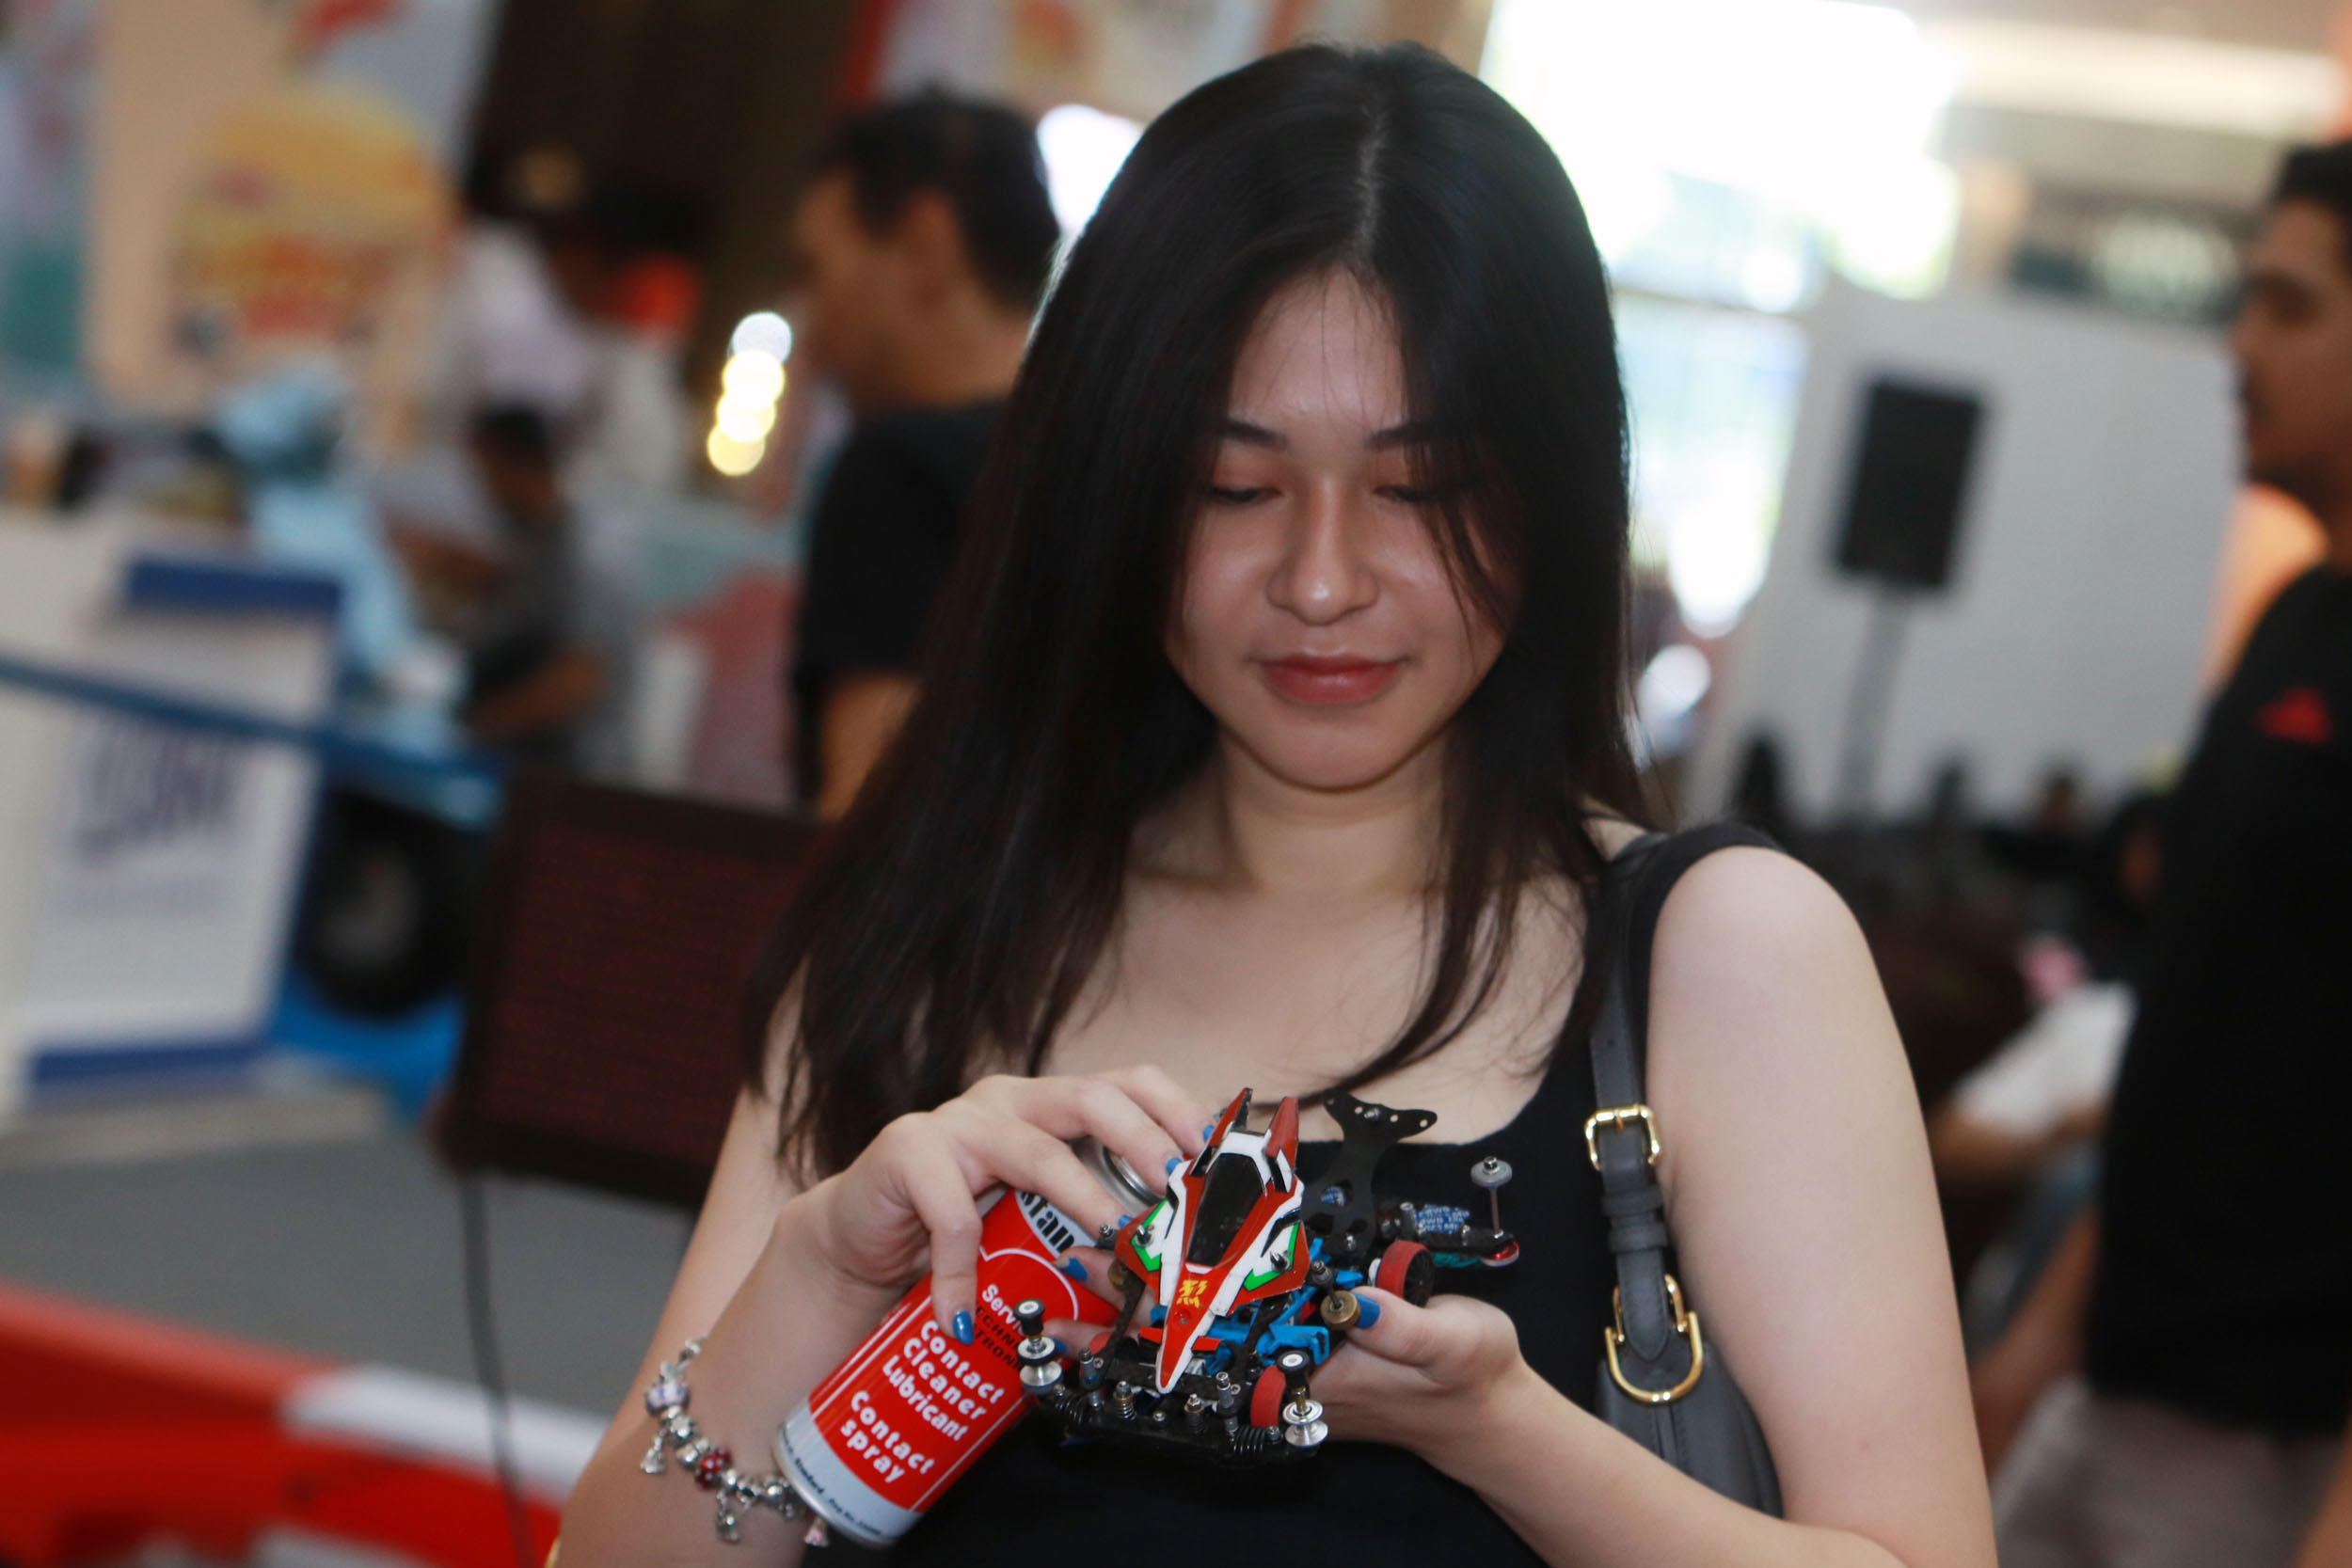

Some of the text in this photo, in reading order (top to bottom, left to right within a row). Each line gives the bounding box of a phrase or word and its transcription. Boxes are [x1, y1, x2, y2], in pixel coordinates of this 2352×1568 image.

[882, 1354, 970, 1442] Lubricant
[903, 1338, 987, 1420] Cleaner
[921, 1321, 1005, 1404] Contact
[850, 1390, 935, 1475] Contact
